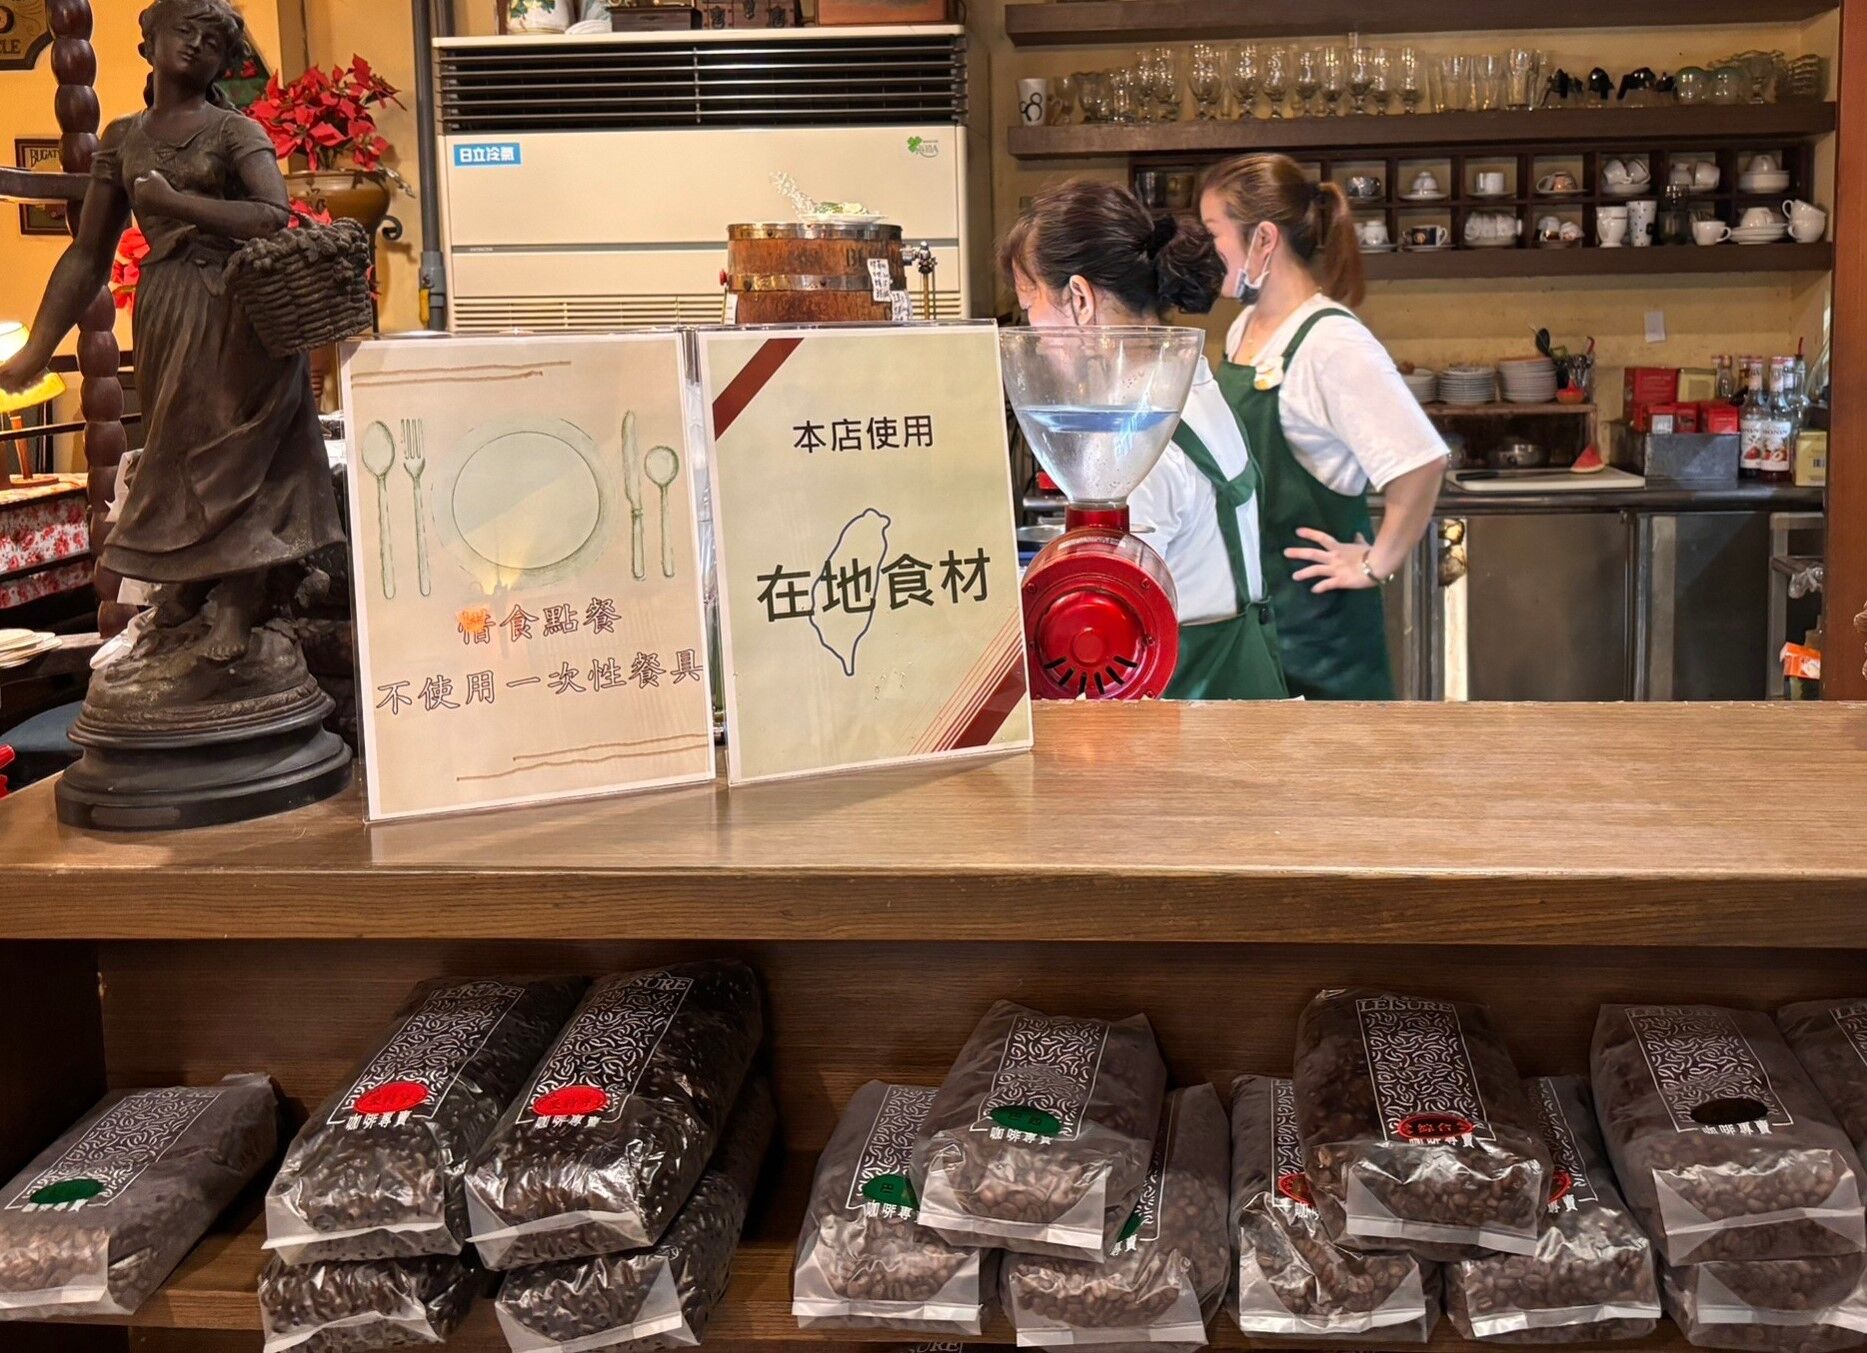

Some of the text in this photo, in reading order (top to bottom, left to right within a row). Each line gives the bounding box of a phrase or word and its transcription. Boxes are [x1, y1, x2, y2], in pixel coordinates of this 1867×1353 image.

[459, 147, 515, 163] 日立冷氣
[793, 415, 934, 453] 本店使用
[757, 548, 991, 622] 在地食材
[376, 649, 704, 715] 不使用一次性餐具
[1360, 1000, 1453, 1013] LEISURE
[866, 1200, 914, 1221] 咖啡專
